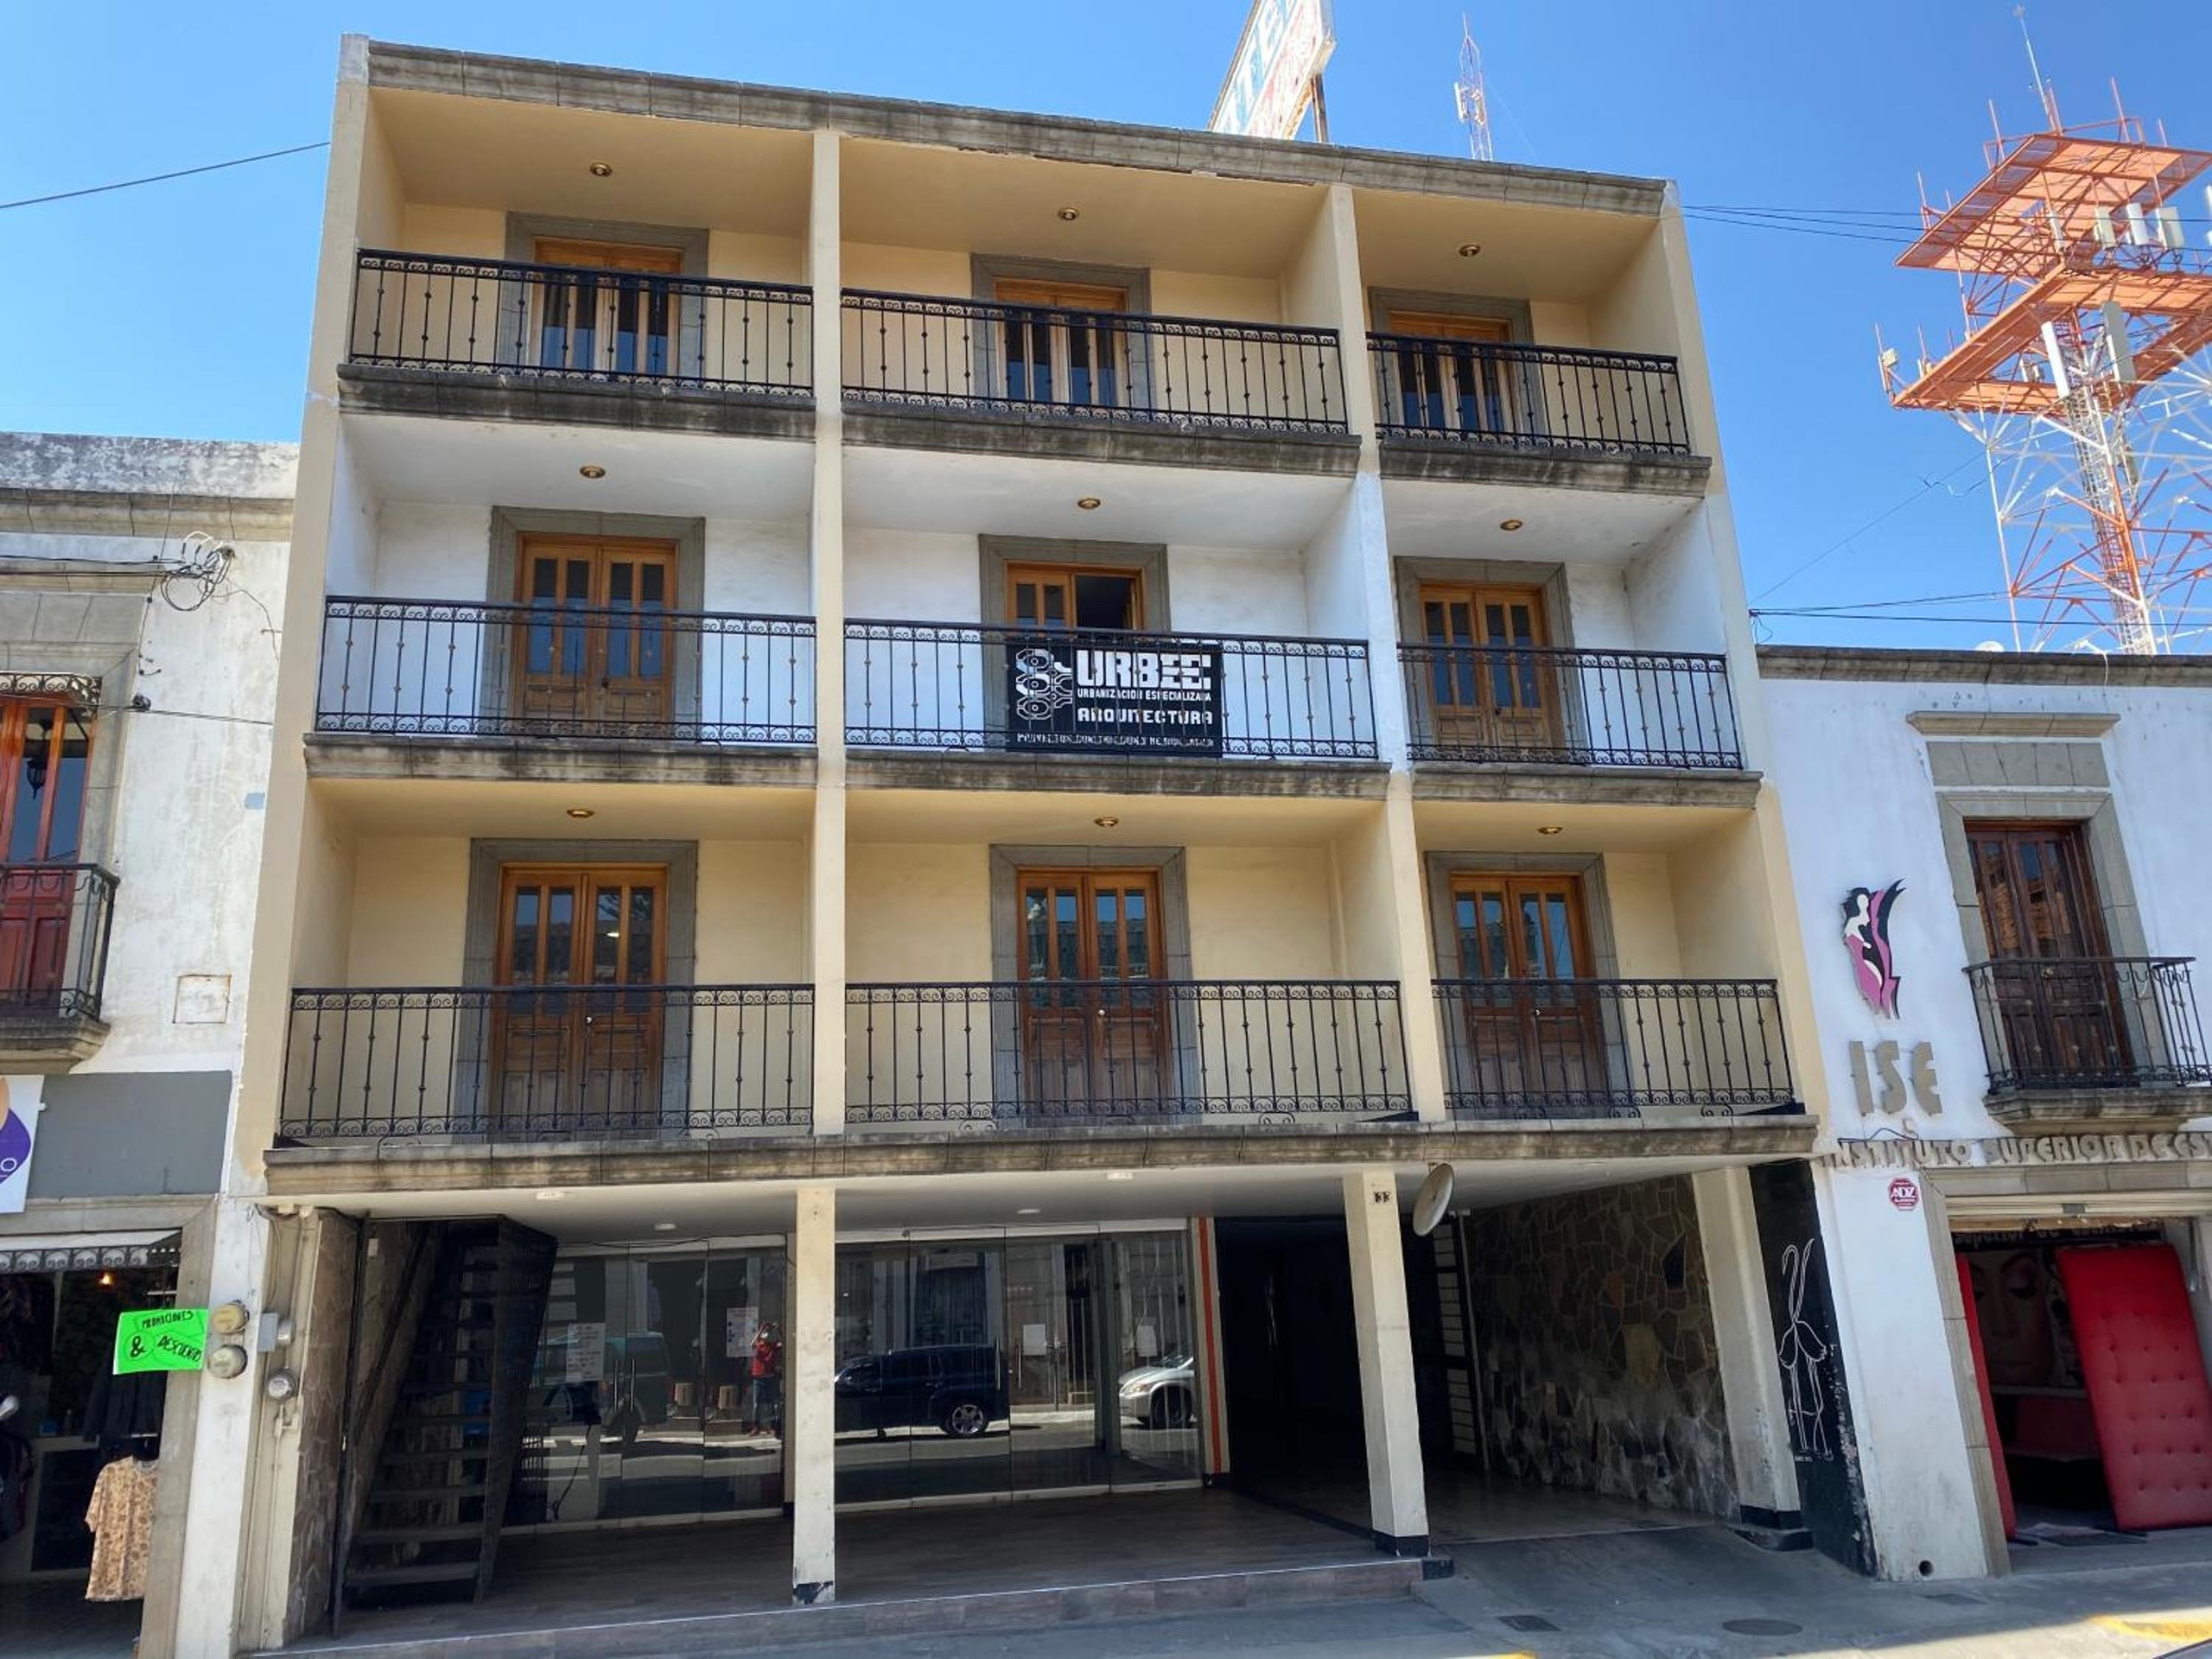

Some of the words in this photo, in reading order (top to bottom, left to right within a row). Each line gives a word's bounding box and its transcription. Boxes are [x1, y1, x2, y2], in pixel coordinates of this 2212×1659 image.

[1849, 1039, 1942, 1116] ISE
[1981, 1134, 2120, 1165] SUPERIOR
[130, 1335, 146, 1357] &
